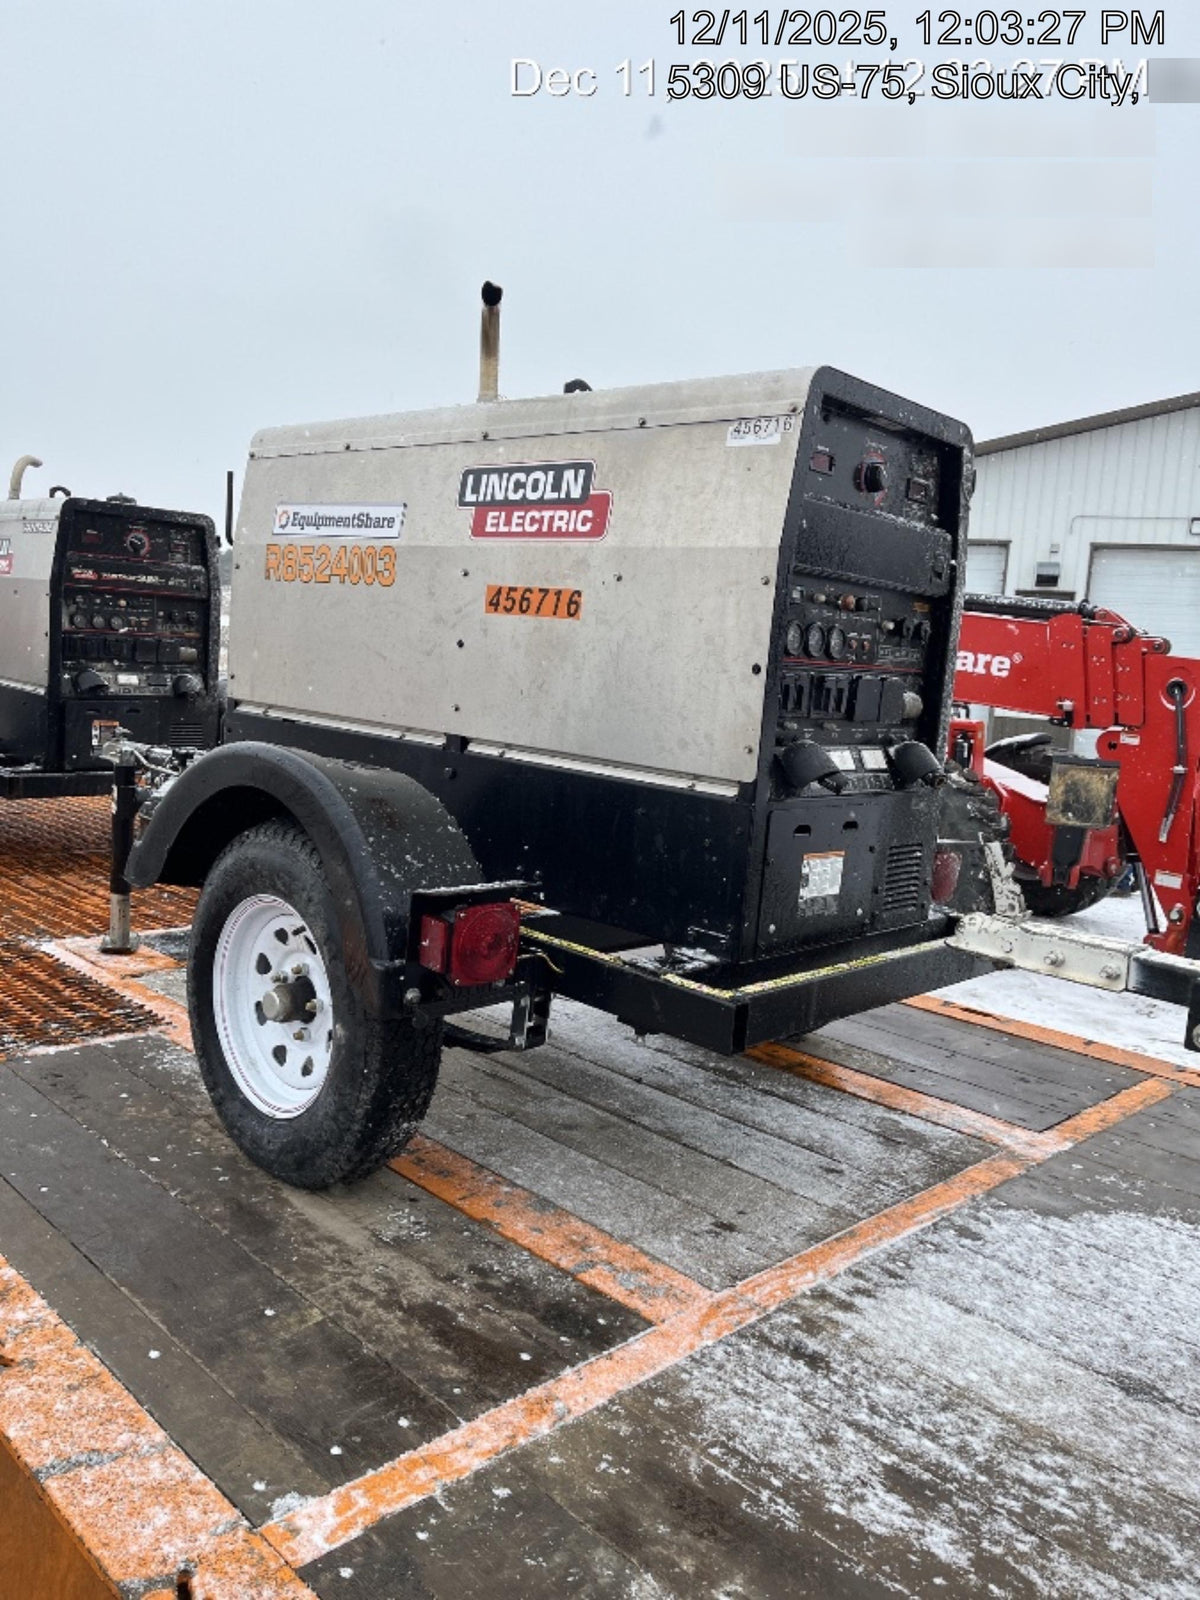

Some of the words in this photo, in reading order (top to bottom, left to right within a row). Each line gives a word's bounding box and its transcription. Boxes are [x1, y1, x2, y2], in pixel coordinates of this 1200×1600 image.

[734, 417, 792, 434] 456716
[465, 469, 586, 502] LINCOLN
[290, 511, 396, 530] EquipmentShare
[484, 509, 593, 534] ELECTRIC
[265, 543, 397, 587] R8524003
[488, 586, 581, 617] 456716
